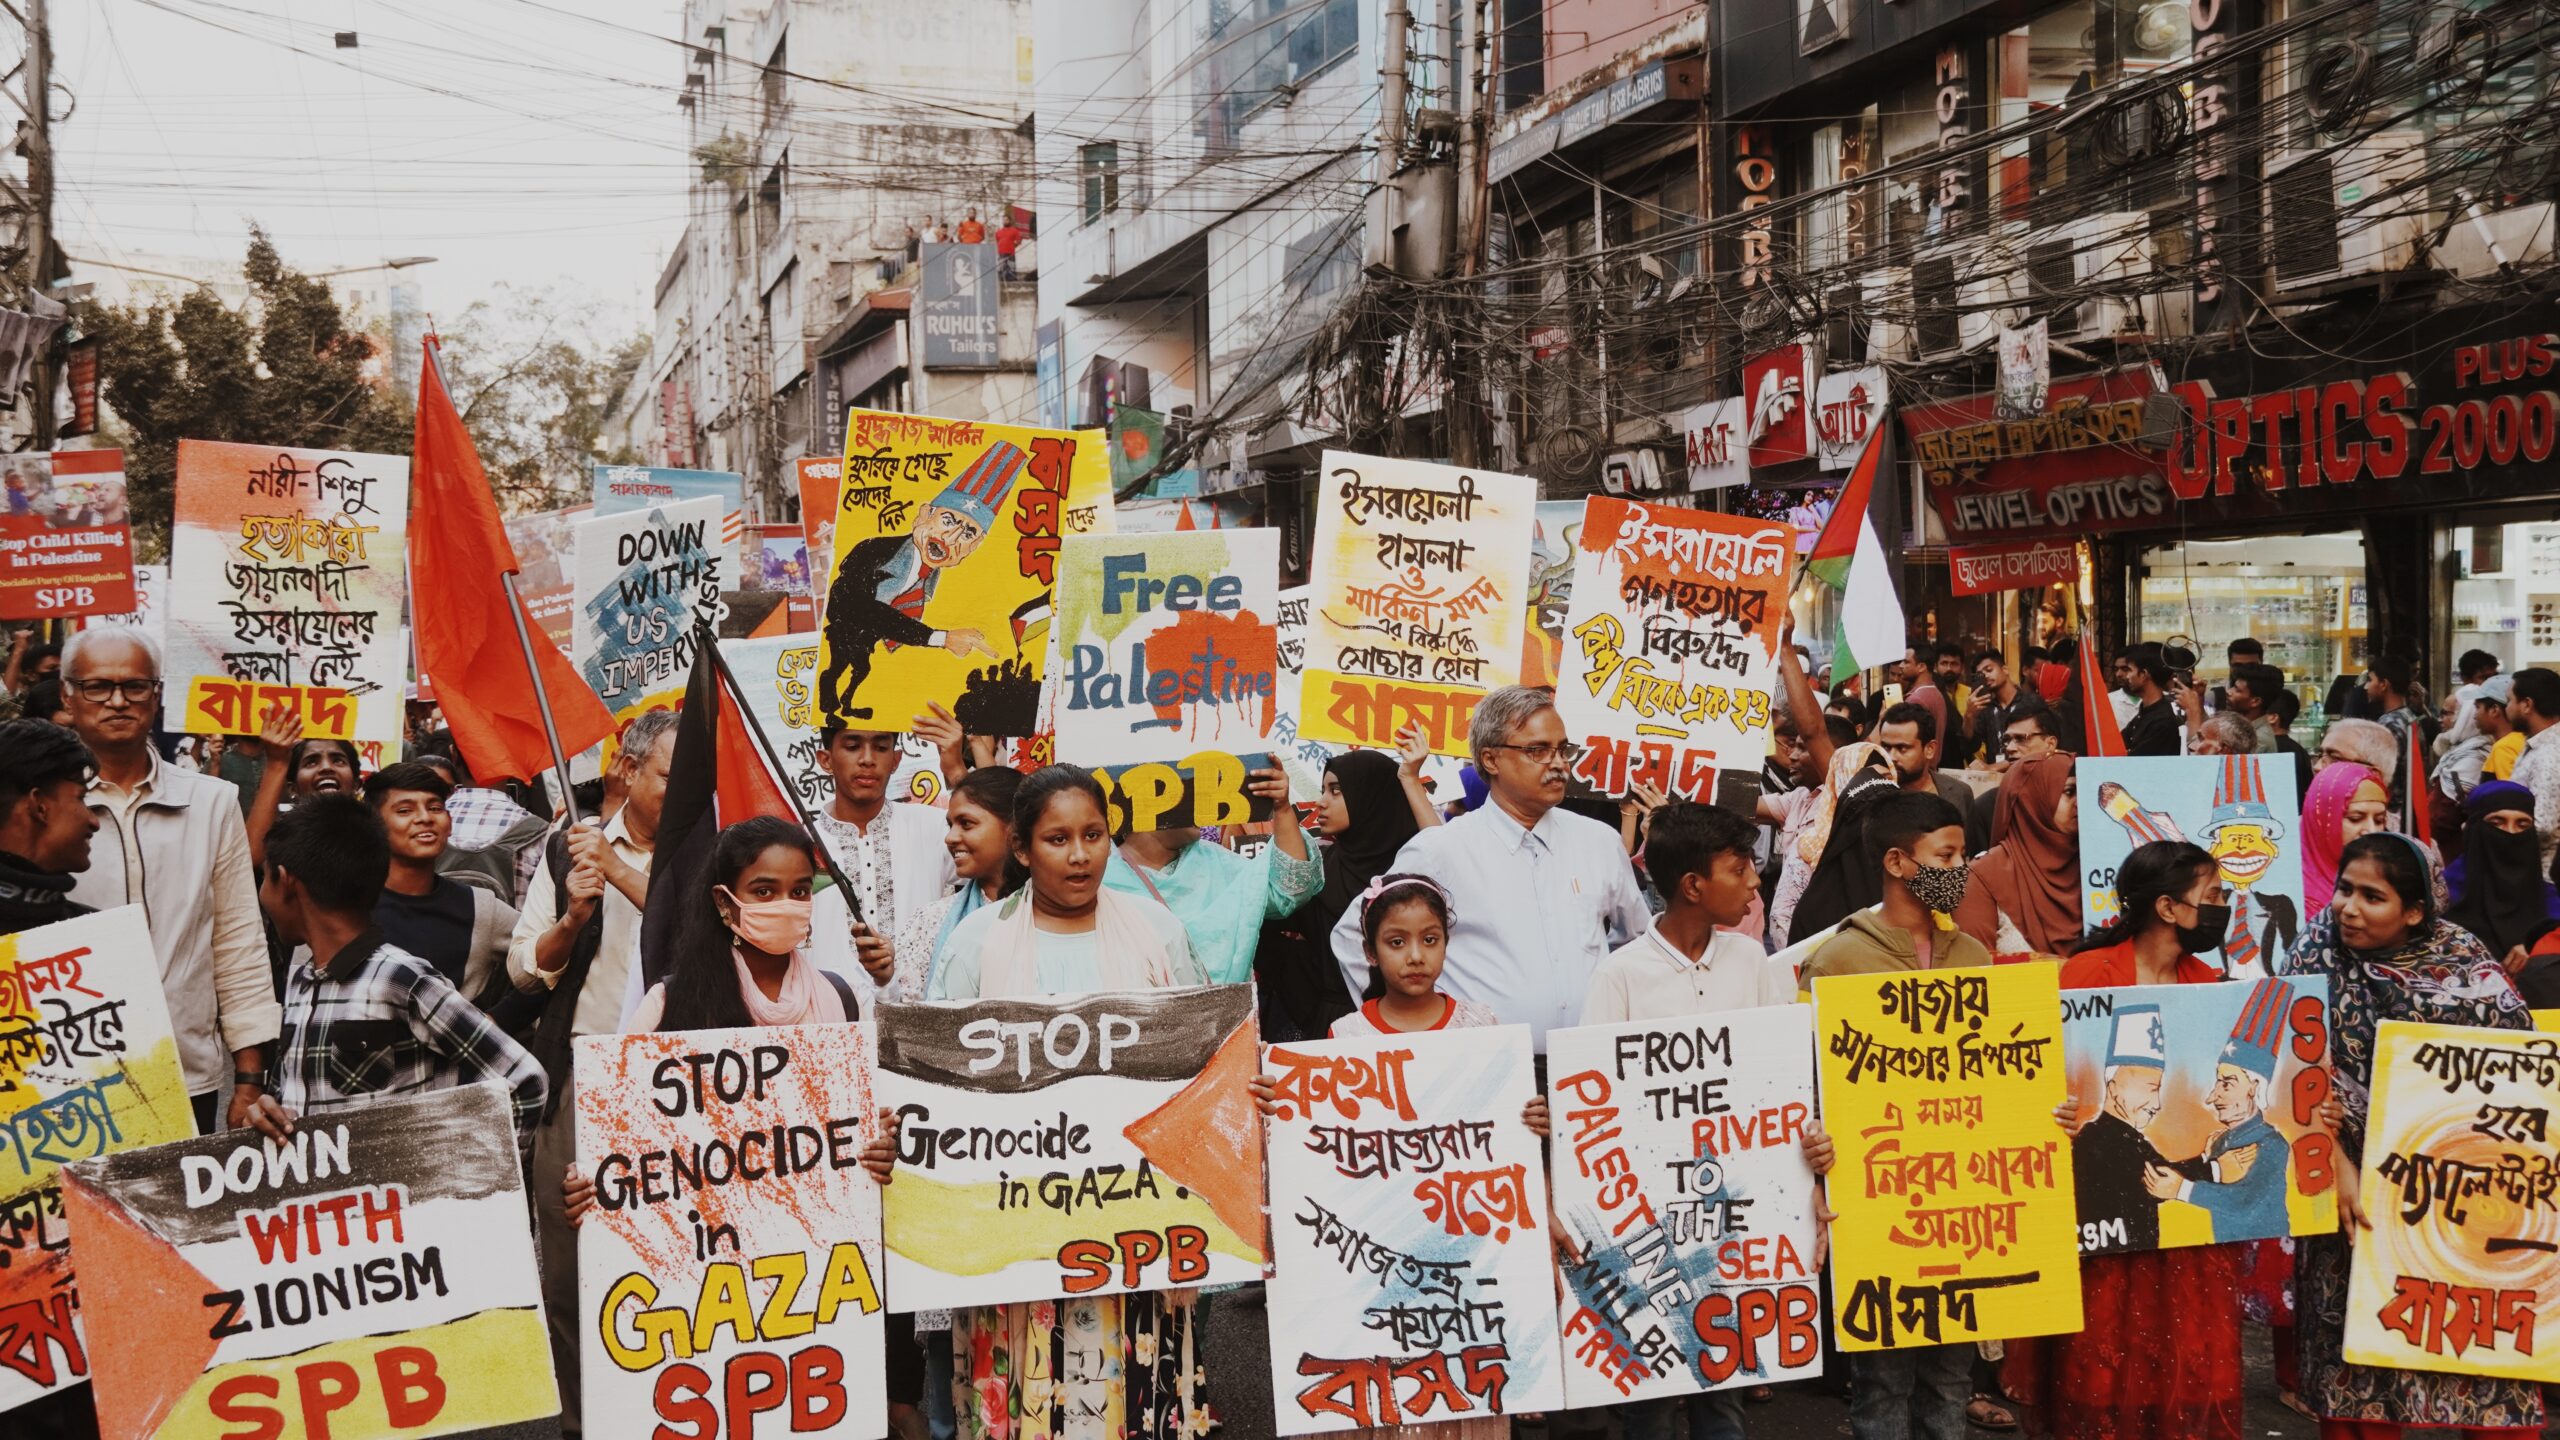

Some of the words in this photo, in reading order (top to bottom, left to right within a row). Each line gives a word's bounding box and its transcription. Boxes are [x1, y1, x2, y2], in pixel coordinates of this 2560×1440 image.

[926, 315, 997, 336] RUHUL'S
[948, 338, 997, 353] Tailors
[2457, 333, 2558, 388] PLUS
[856, 414, 931, 451] যুদ্ধবাজ
[928, 421, 984, 448] মার্কিন
[1687, 423, 1730, 465] ART
[2169, 372, 2411, 499] OPTICS
[2421, 393, 2557, 475] 2000
[849, 447, 900, 484] ফুরিয়ে
[904, 452, 953, 481] গেছে
[843, 486, 892, 512] তোদের
[878, 501, 914, 532] দিন
[1952, 488, 2046, 531] JEWEL
[2047, 474, 2164, 526] OPTICS
[12, 554, 28, 567] in
[30, 550, 102, 566] Palestine
[28, 534, 70, 548] Child
[73, 531, 125, 547] Killing
[239, 511, 380, 564] হত্যাকারী
[618, 520, 705, 566] DOWN
[1376, 533, 1475, 572] হামলা
[35, 586, 96, 609] SPB
[225, 560, 370, 604] জায়নবাদী
[618, 559, 700, 607] WITH
[1102, 552, 1242, 614] Free
[1345, 583, 1445, 629] মার্কিন
[1442, 576, 1503, 624] মদদ
[1400, 566, 1426, 591] ও
[1623, 575, 1767, 635] গণহত্যার
[218, 602, 378, 646] ইসরায়েলের
[626, 605, 668, 645] US
[1642, 614, 1750, 676] বিরুদ্ধে
[222, 651, 299, 687] ক্ষমা
[309, 646, 364, 686] নেই
[1065, 636, 1272, 710] Palestine
[1432, 656, 1489, 682] হোন
[1608, 656, 1689, 718] বিবেক
[1680, 683, 1730, 725] এক
[1729, 687, 1772, 734] হও
[1877, 975, 1990, 1034] গাজায়
[958, 1012, 1140, 1082] STOP
[1615, 1025, 1733, 1081] FROM
[1830, 1018, 1951, 1085] মানবতার
[652, 1045, 790, 1118] STOP
[1267, 1046, 1419, 1121] রুখো
[1644, 1077, 1731, 1122] THE
[2289, 994, 2336, 1198] SPB
[895, 1103, 1092, 1170] Genocide
[1692, 1101, 1809, 1159] RIVER
[1860, 1101, 1904, 1142] এ
[1916, 1095, 1983, 1130] সময়
[2472, 1102, 2549, 1143] হবে
[180, 1123, 351, 1209] DOWN
[594, 1116, 860, 1211] GENOCIDE
[1303, 1119, 1495, 1180] সাম্রাজ্যবাদ
[1665, 1158, 1724, 1196] TO
[1862, 1138, 1958, 1208] নিরব
[1965, 1141, 2058, 1197] থাকা
[997, 1170, 1029, 1211] in
[1413, 1163, 1537, 1245] গড়ো
[1555, 1068, 1694, 1318] PALESTINE
[244, 1187, 405, 1265] WITH
[687, 1210, 741, 1262] in
[1665, 1198, 1755, 1246] THE
[1889, 1200, 2027, 1261] অন্যায়
[1056, 1225, 1210, 1294] SPB
[1716, 1234, 1807, 1281] SEA
[203, 1245, 450, 1340] ZIONISM
[599, 1241, 882, 1373] GAZA
[1567, 1240, 1640, 1342] WILL
[1632, 1323, 1688, 1380] BE
[1840, 1269, 2041, 1348] বাসদ
[2376, 1273, 2537, 1360] বাসদ
[1361, 1301, 1506, 1352] সাম্যবাদ
[1563, 1304, 1652, 1397] FREE
[1692, 1284, 1820, 1385] SPB
[207, 1345, 447, 1440] SPB
[651, 1344, 848, 1440] SPB
[1295, 1343, 1511, 1428] বাসদ
